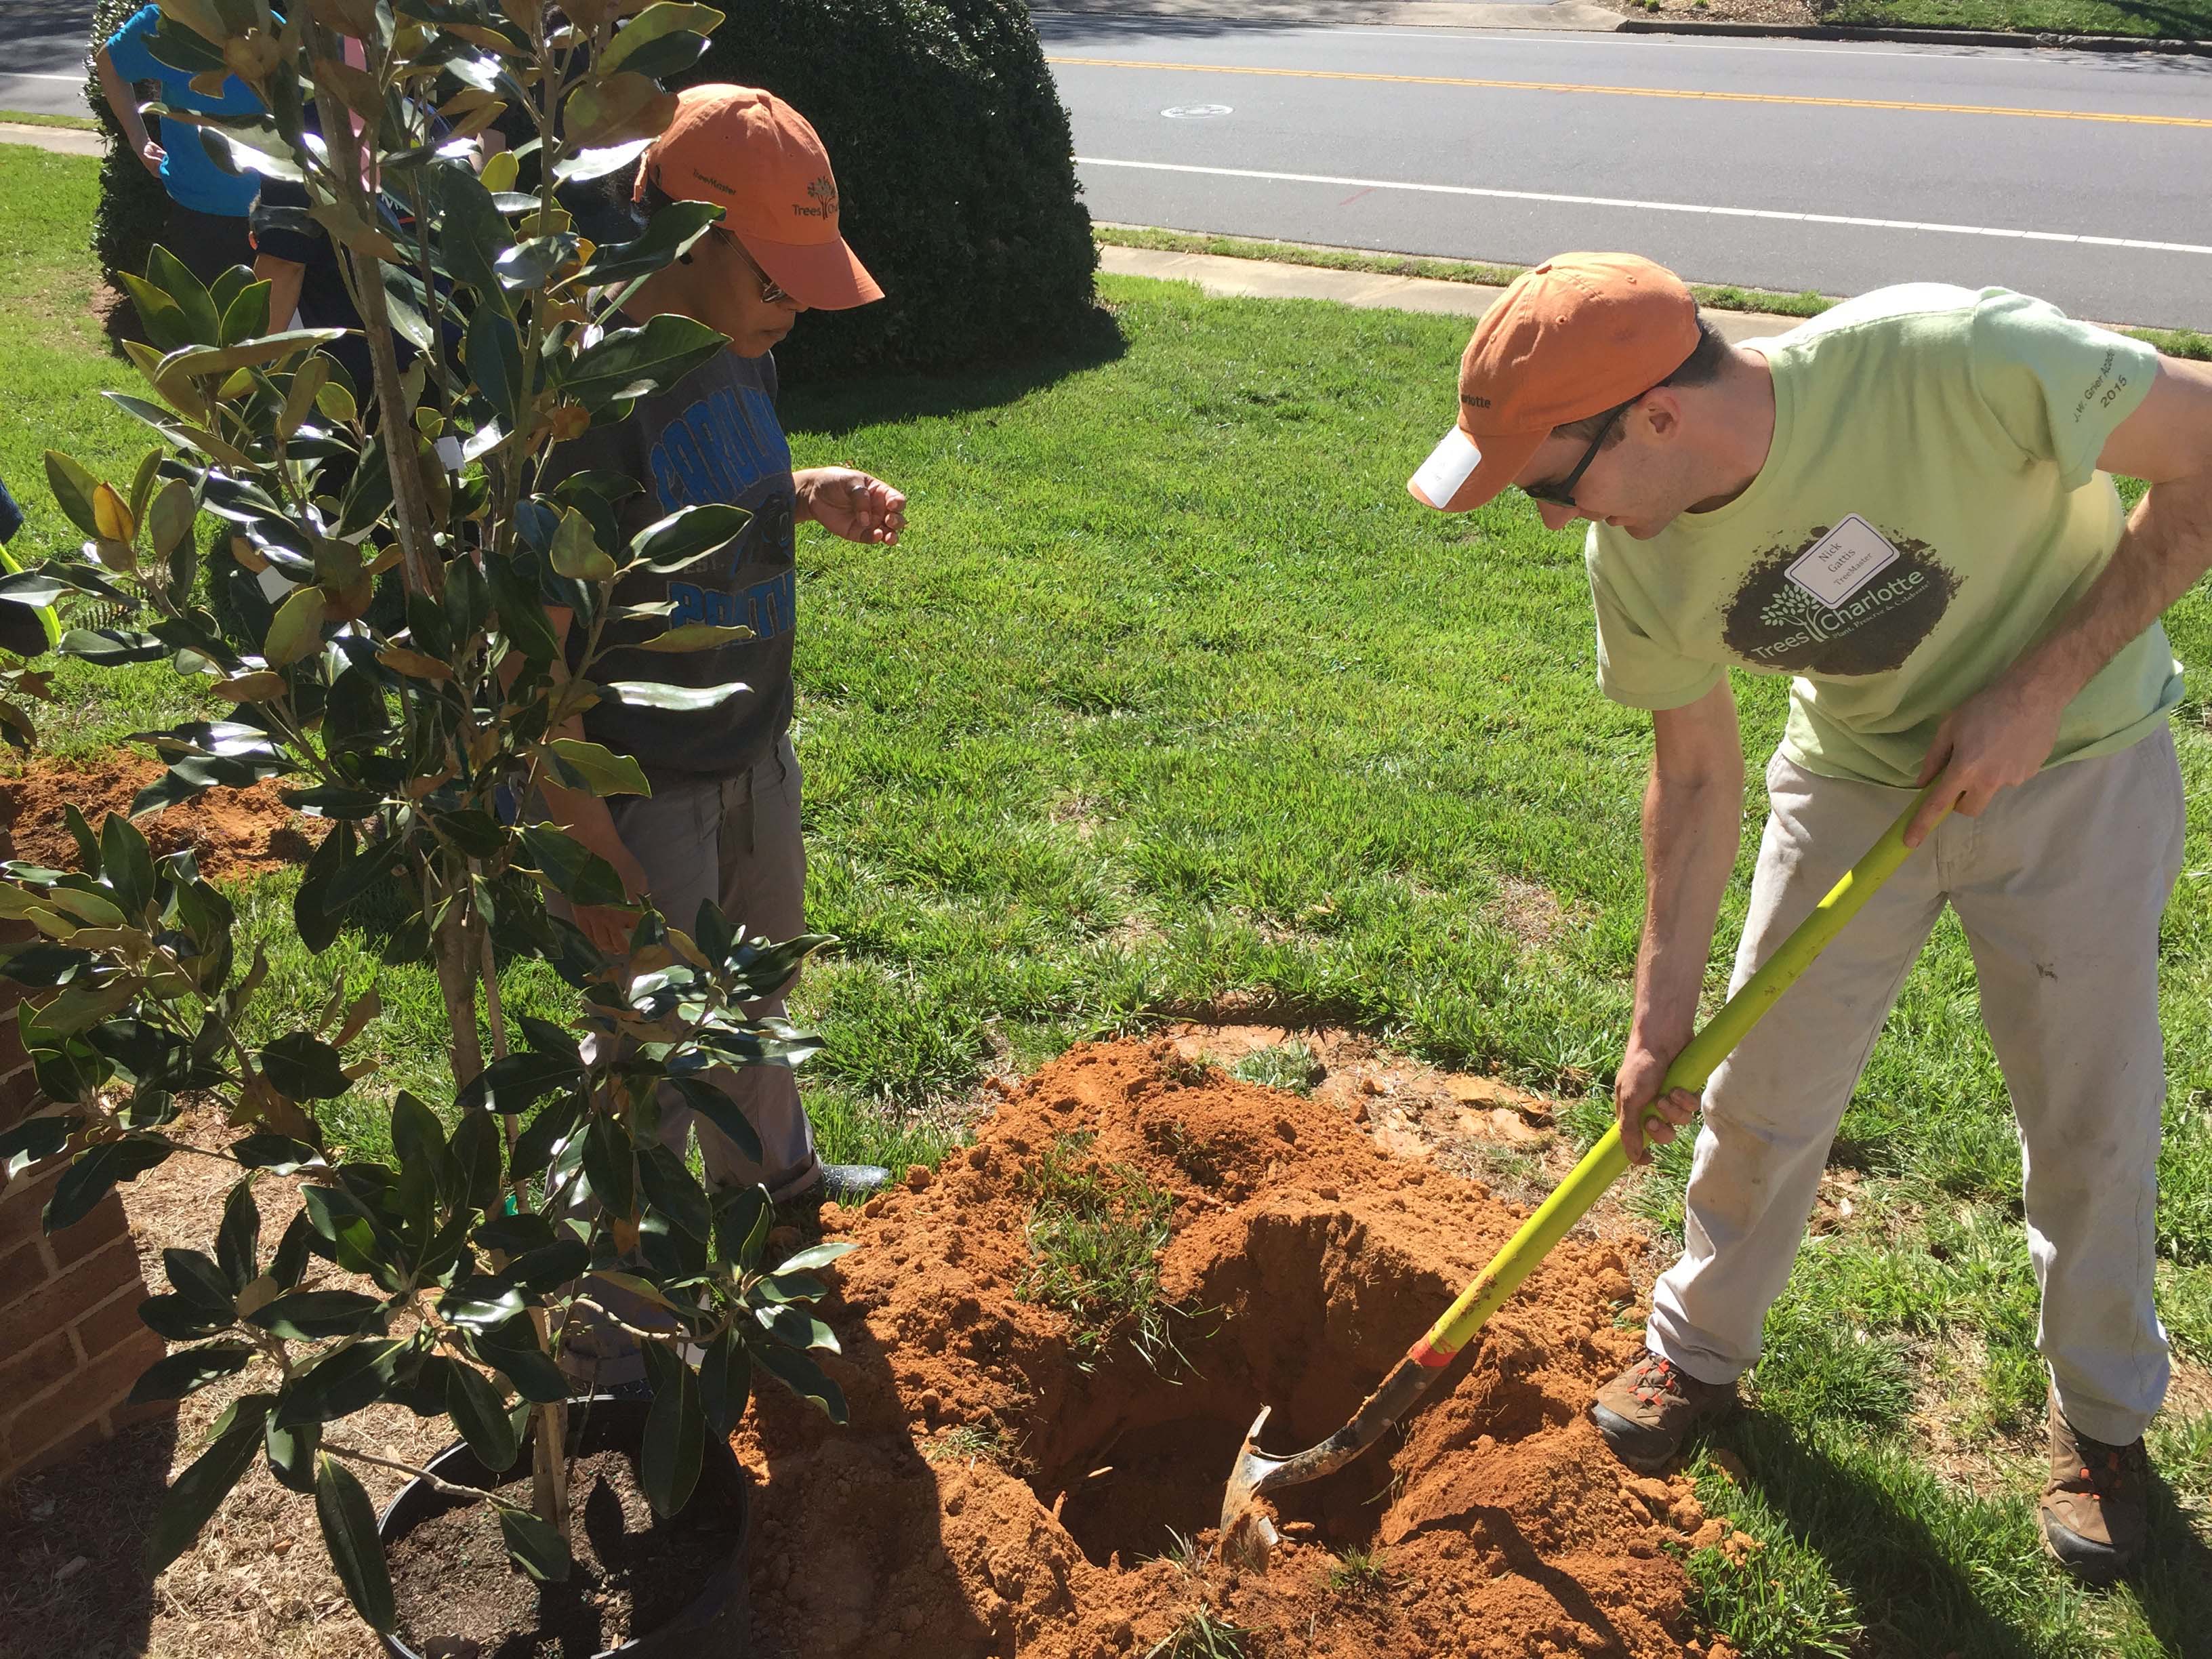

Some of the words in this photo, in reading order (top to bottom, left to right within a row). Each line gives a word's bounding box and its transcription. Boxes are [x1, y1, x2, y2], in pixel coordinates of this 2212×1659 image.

[791, 203, 821, 216] Trees
[2084, 375, 2104, 400] Grier
[2100, 374, 2127, 408] 2015
[1818, 542, 1843, 563] Nick
[1827, 549, 1856, 573] Gattis
[1833, 552, 1872, 586] TreeMaster
[1750, 631, 1810, 659] Trees
[1820, 571, 1925, 631] Charlotte
[1832, 626, 1855, 639] Plant,
